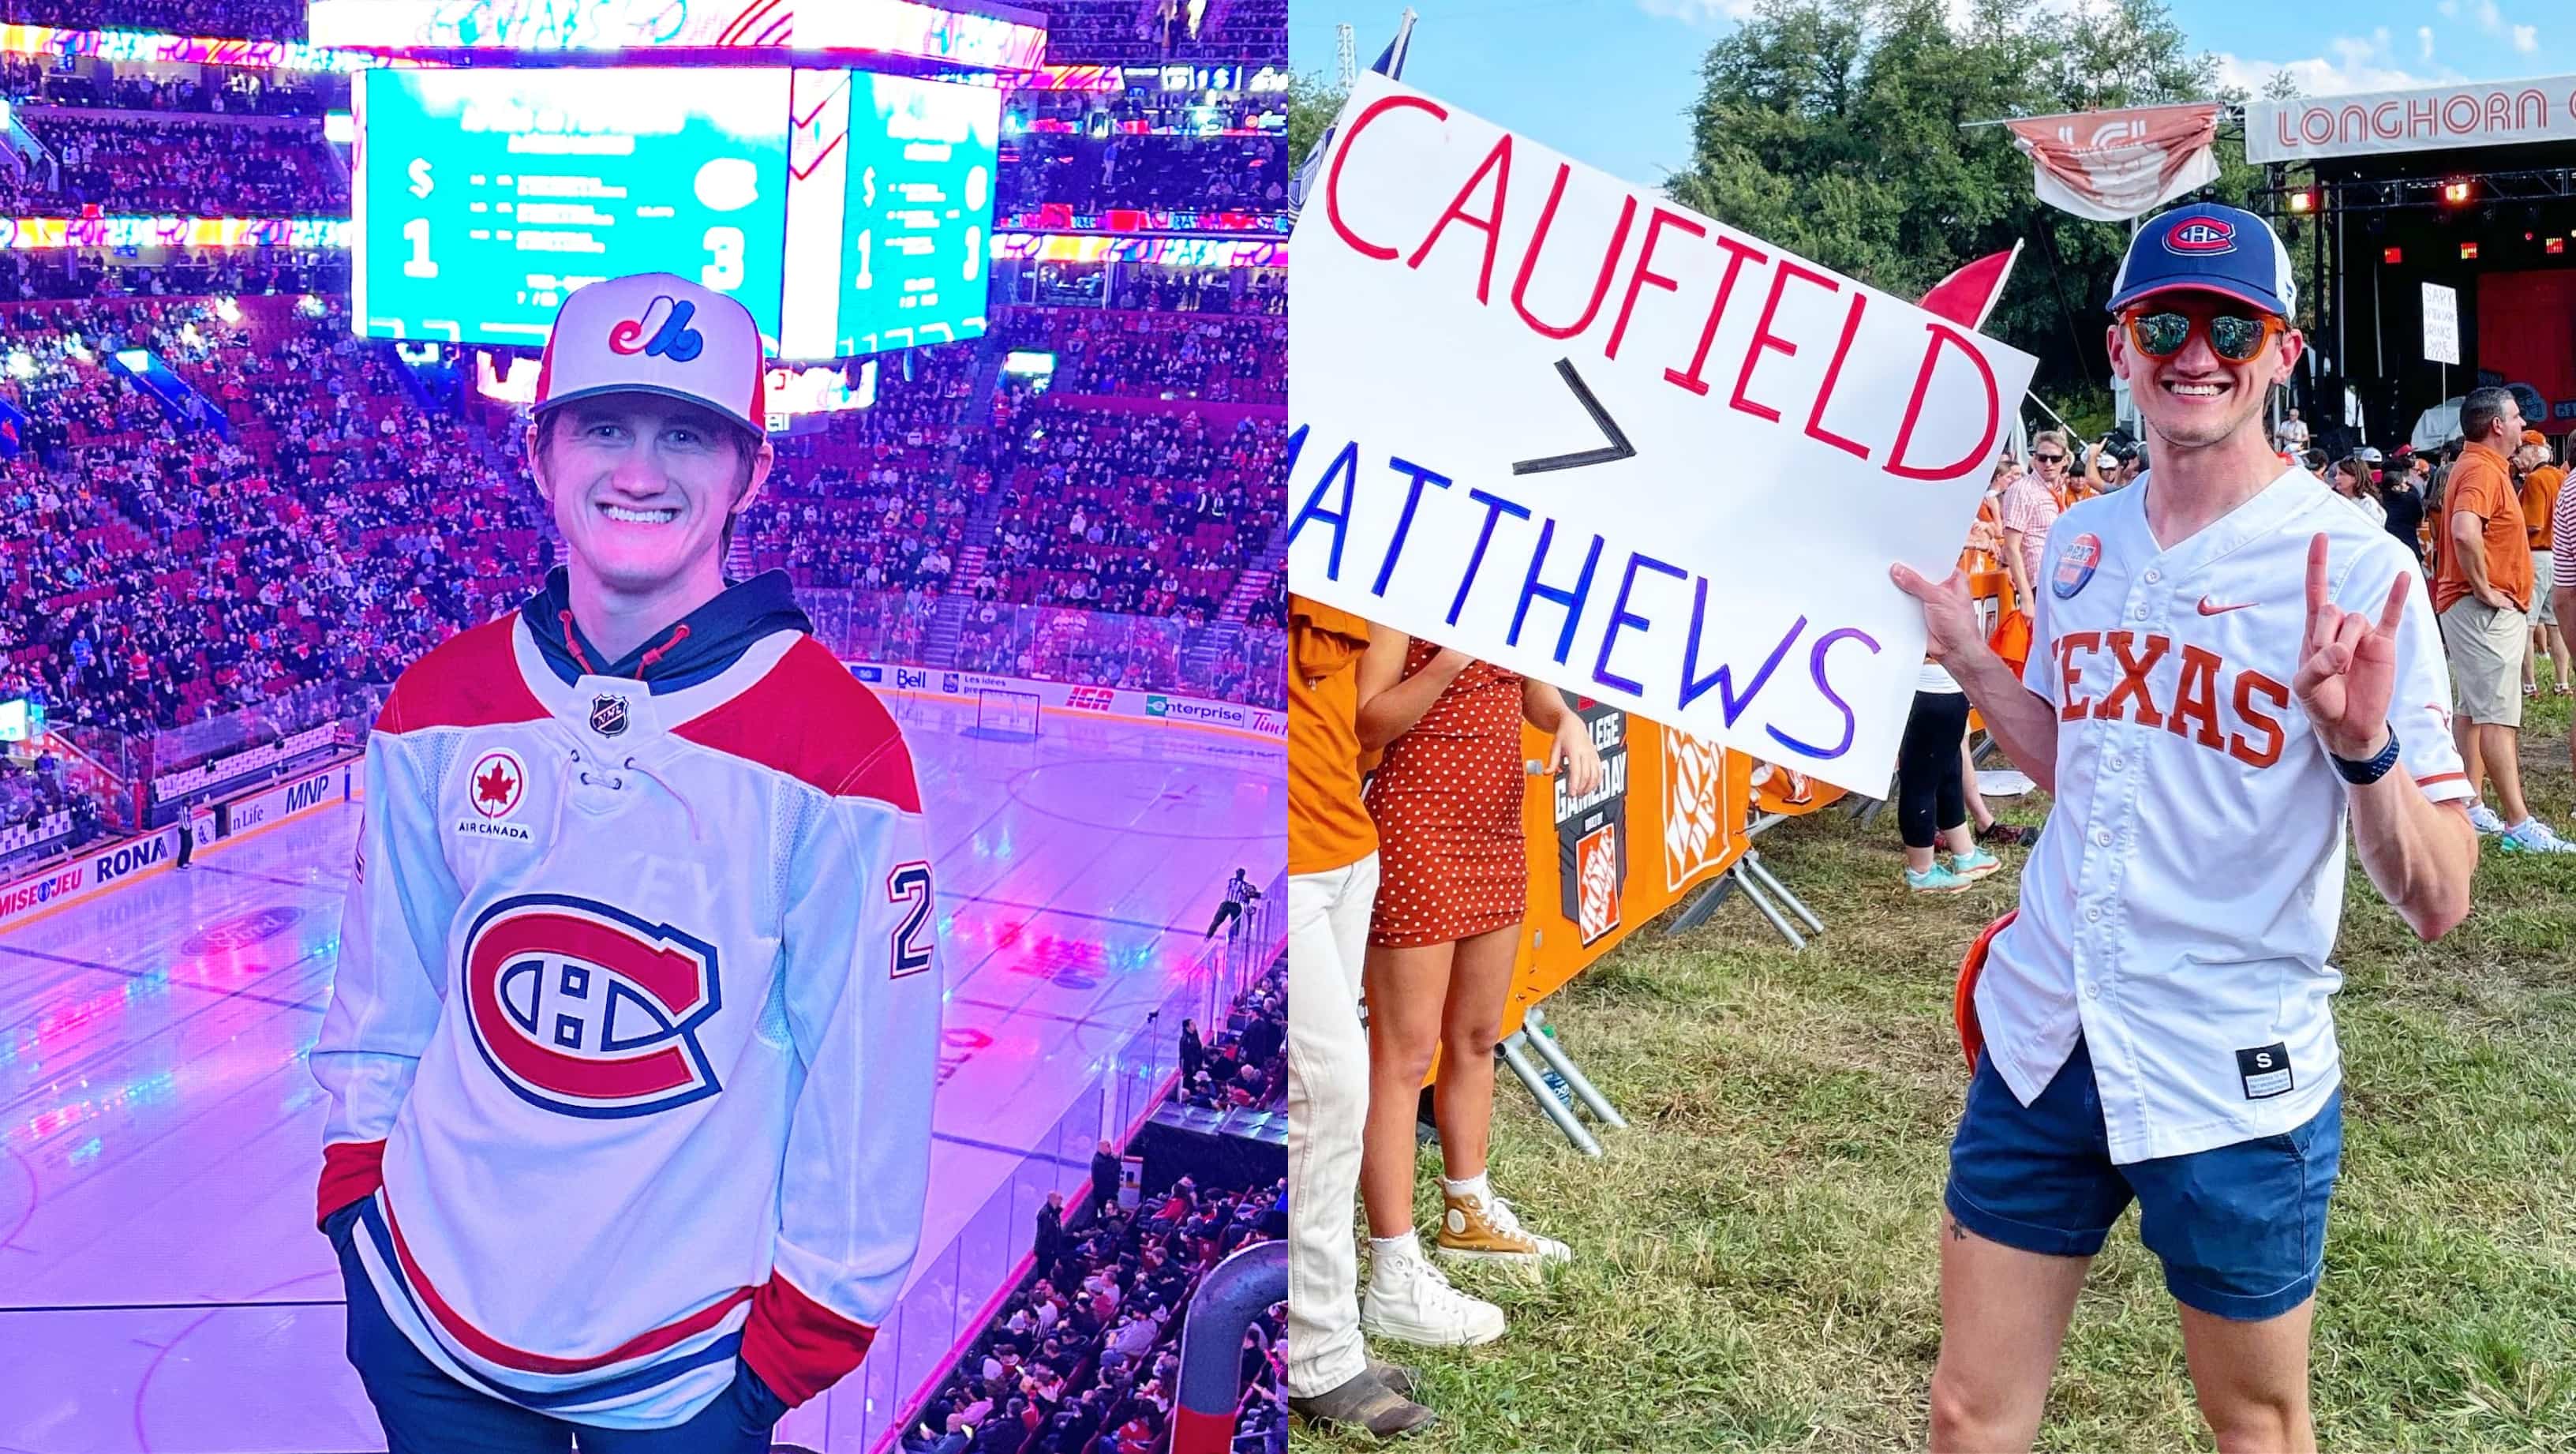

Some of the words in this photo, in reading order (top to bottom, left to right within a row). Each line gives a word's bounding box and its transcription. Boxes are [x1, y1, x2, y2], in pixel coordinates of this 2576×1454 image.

[2278, 88, 2548, 148] LONGHORN
[403, 217, 439, 278] 1
[702, 227, 745, 290] 3
[1326, 94, 2000, 482] CAUFIELD
[897, 668, 927, 688] Bell
[964, 675, 979, 684] Les
[1066, 687, 1115, 711] IGA
[1147, 697, 1242, 721] enterprise
[2051, 631, 2290, 770] EXAS
[598, 705, 622, 726] NHL
[1252, 711, 1279, 735] Tim
[285, 774, 329, 815] MNP
[243, 804, 264, 827] Life
[459, 823, 477, 833] AIR
[479, 823, 529, 840] CANADA
[96, 836, 169, 884] RONA
[886, 860, 934, 980] 2
[2256, 1052, 2273, 1069] S
